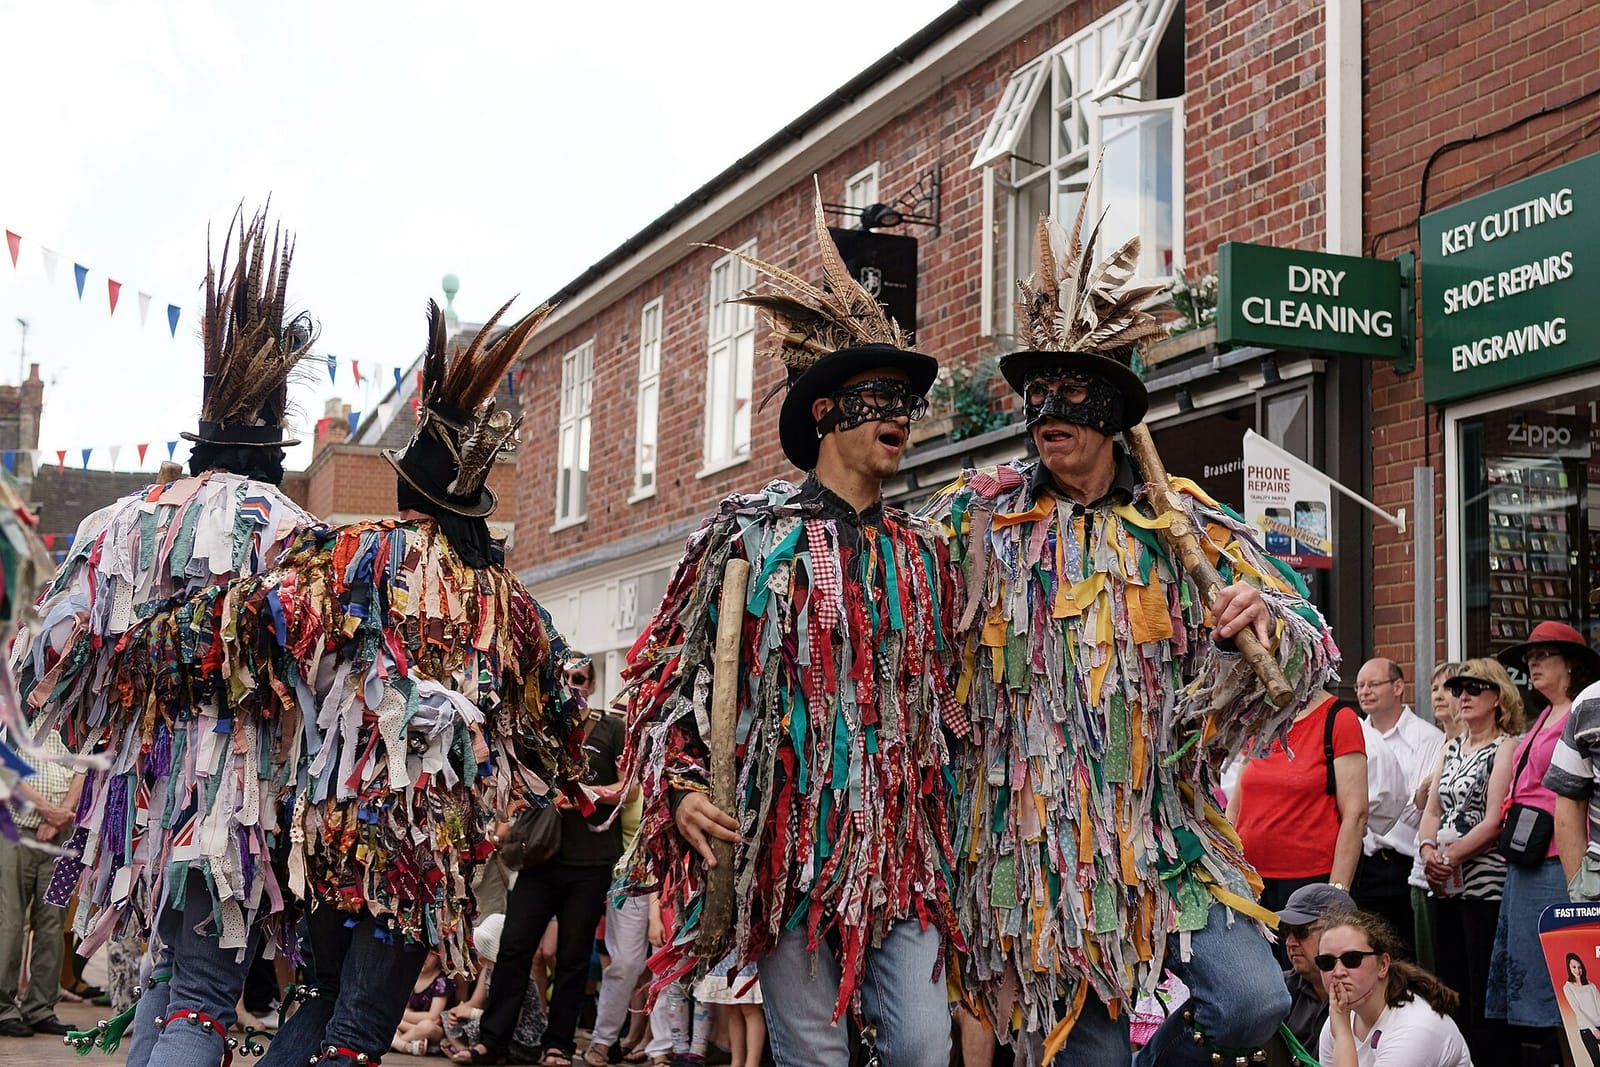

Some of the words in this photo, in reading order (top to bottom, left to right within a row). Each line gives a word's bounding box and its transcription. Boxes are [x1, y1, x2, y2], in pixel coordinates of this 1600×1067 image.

[1441, 221, 1477, 256] KEY
[1481, 188, 1573, 242] CUTTING
[1287, 265, 1346, 297] DRY
[1443, 276, 1495, 315] SHOE
[1499, 251, 1574, 299] REPAIRS
[1241, 296, 1393, 338] CLEANING
[1451, 317, 1567, 373] ENGRAVING
[1247, 465, 1290, 481] PHONE
[1248, 480, 1291, 494] REPAIRS
[1554, 907, 1575, 918] FAST
